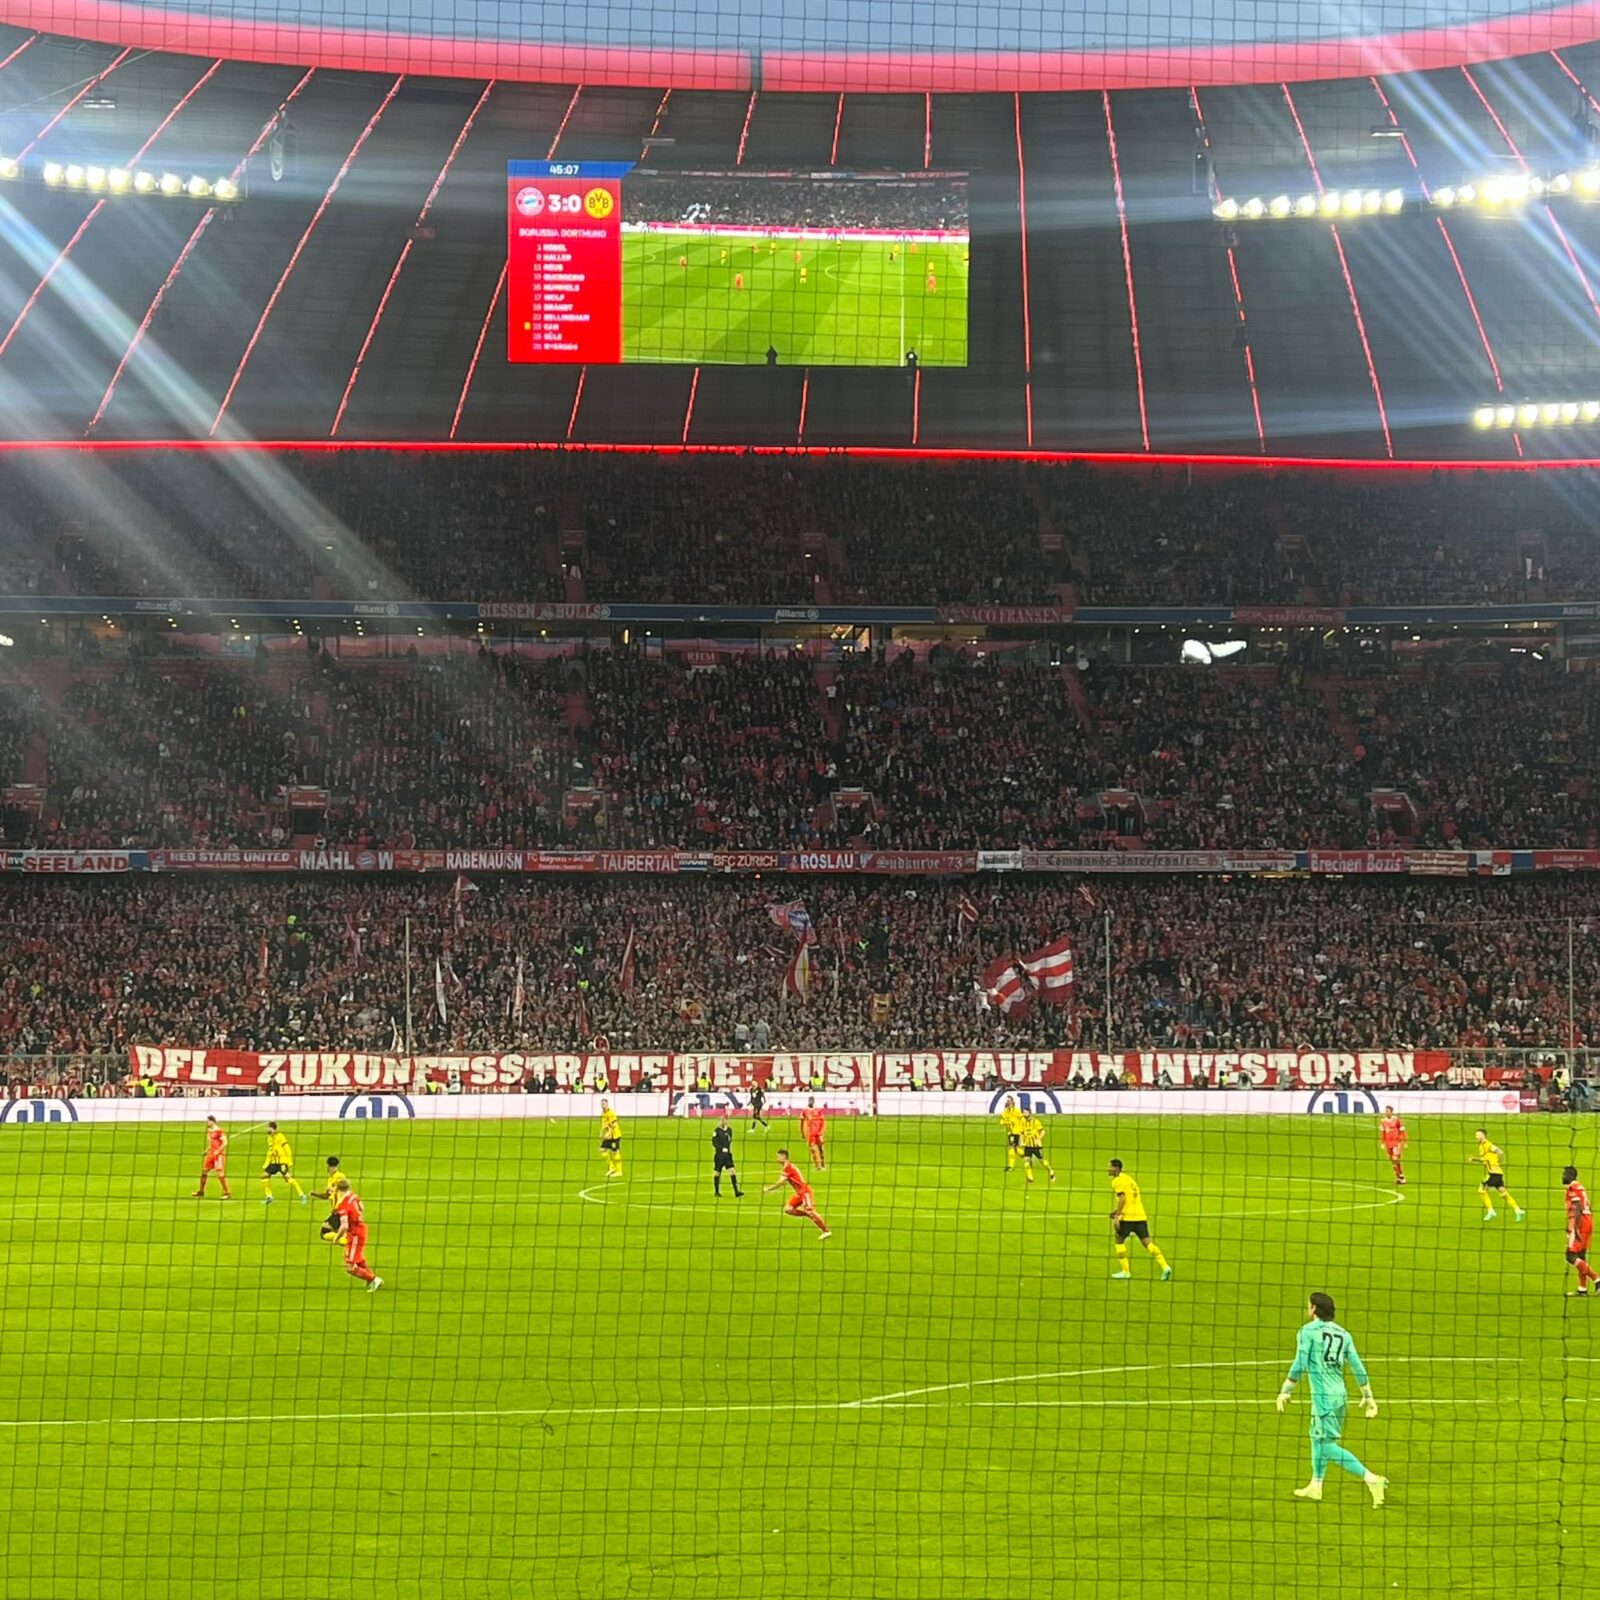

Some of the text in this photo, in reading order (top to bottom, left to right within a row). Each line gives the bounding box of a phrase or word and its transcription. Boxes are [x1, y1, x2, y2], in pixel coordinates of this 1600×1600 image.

[549, 164, 580, 175] 45:07
[547, 193, 583, 214] 3:0
[353, 604, 386, 614] Allianz
[478, 603, 602, 619] GIESSEN BULLS
[1000, 607, 1059, 622] FRANKEN
[23, 856, 128, 871] SEELAND
[199, 852, 240, 862] STARS
[243, 852, 290, 862] UNITED
[601, 854, 679, 872] TAUBERTAL
[713, 856, 736, 866] BFC
[800, 853, 854, 870] RÖSLAU
[134, 1045, 218, 1082] DFL
[1067, 1053, 1125, 1085] AN
[1322, 1332, 1344, 1363] 27
